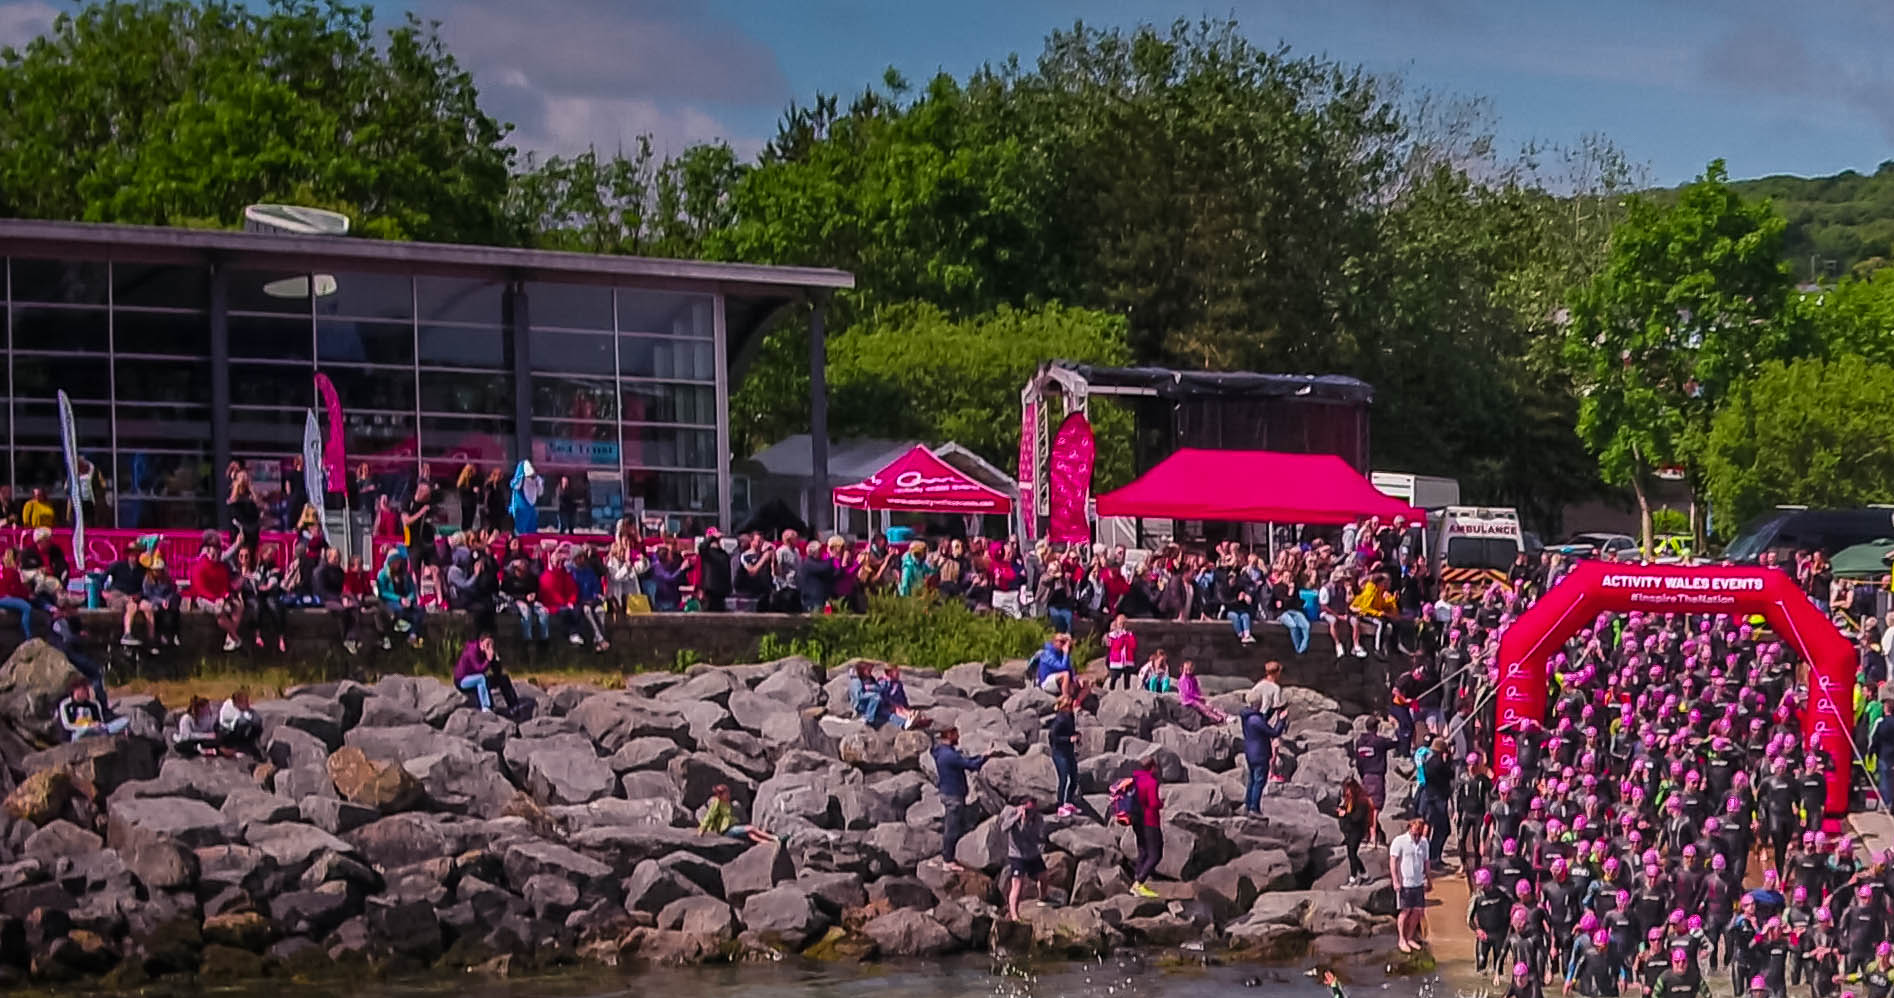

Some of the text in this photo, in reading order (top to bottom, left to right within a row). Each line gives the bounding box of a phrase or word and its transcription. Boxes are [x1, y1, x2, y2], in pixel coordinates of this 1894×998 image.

[1448, 524, 1517, 535] AMBULANCE
[1602, 575, 1763, 591] ACTIVITY WALES EVENTS
